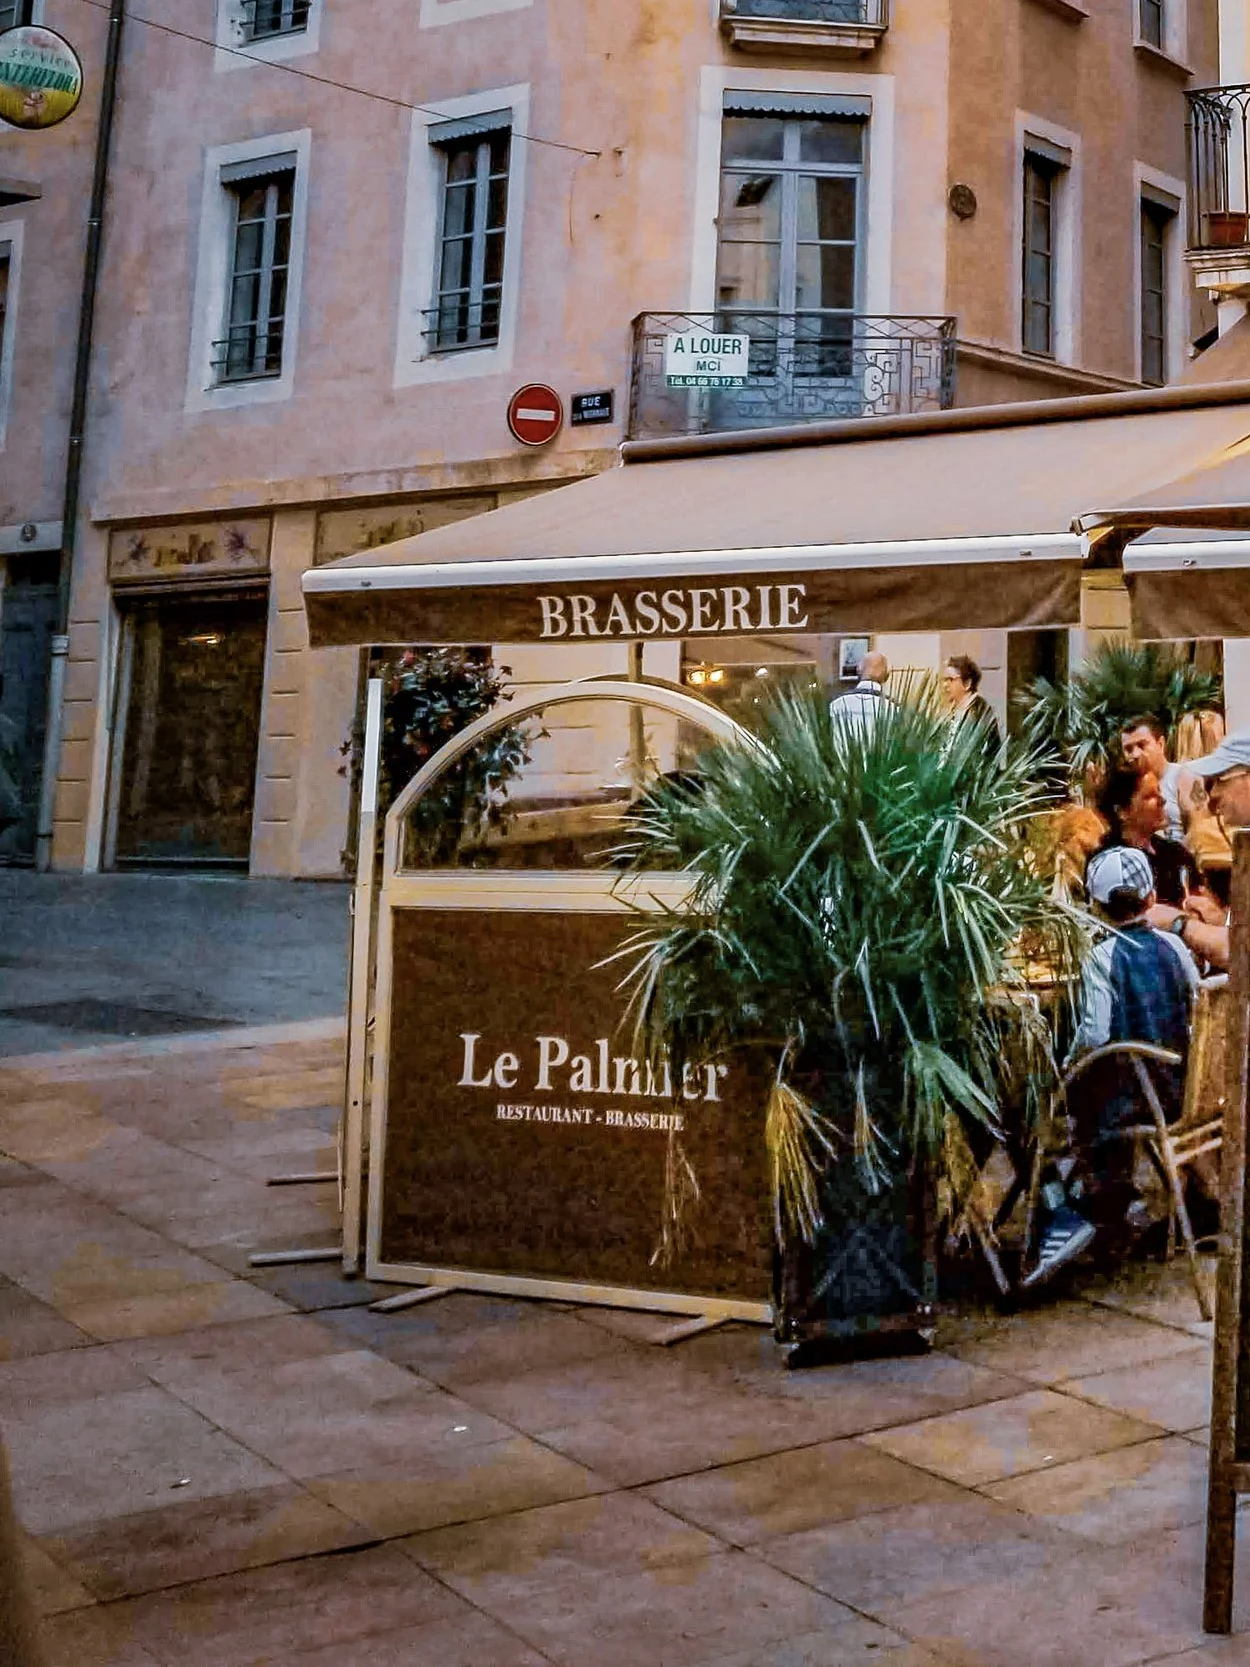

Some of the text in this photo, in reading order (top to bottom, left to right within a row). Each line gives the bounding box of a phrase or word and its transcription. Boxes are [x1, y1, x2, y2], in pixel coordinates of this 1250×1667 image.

[673, 337, 742, 354] A LOUER
[581, 396, 601, 407] RUE
[536, 584, 809, 638] BRASSERIE
[456, 1034, 520, 1088] Le
[497, 1104, 592, 1125] RESTAURANT
[605, 1110, 685, 1131] BRASSERIE
